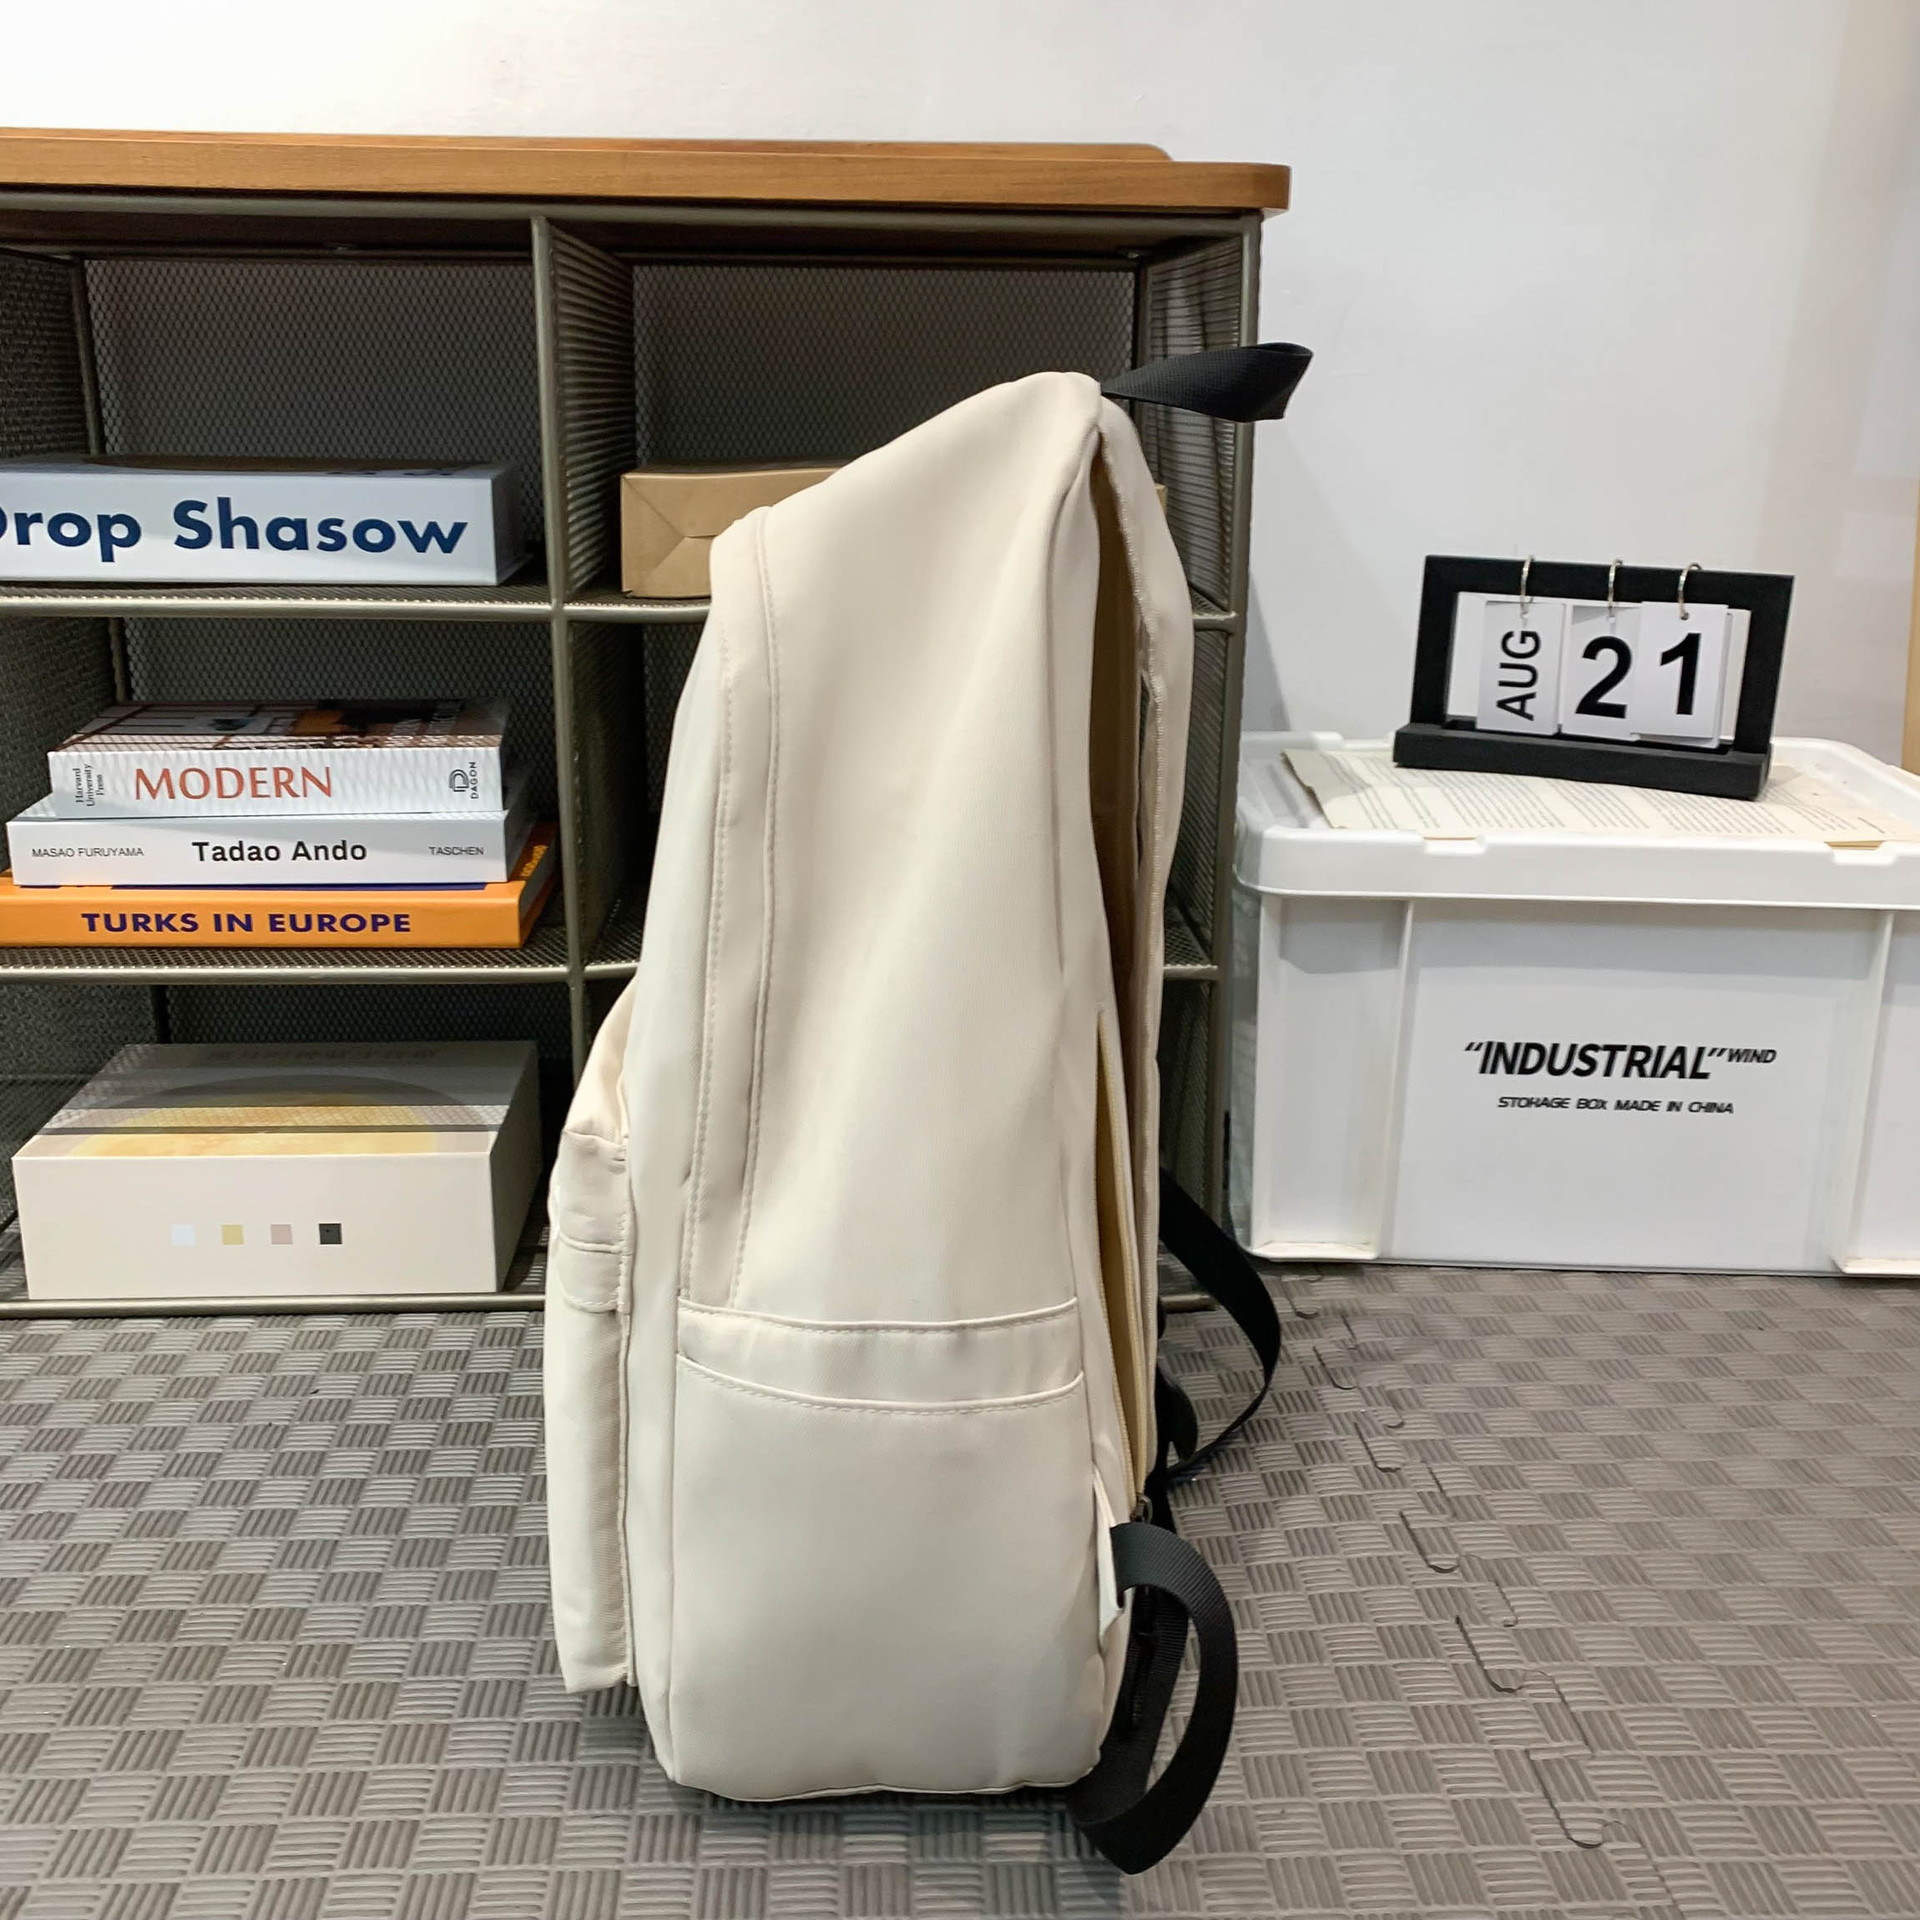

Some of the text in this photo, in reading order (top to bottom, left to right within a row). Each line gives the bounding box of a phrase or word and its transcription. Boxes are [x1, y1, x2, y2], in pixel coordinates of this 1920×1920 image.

[0, 496, 468, 562] rop Shasow
[1496, 630, 1541, 721] AUG
[74, 767, 84, 803] Harvard
[85, 763, 94, 807] University
[135, 767, 332, 800] MODERN
[469, 761, 479, 799] DAGON
[31, 847, 144, 858] MASAO FURUYAMA
[191, 839, 367, 862] Tadao Ando
[428, 846, 484, 856] TASCHEN
[81, 912, 411, 932] TURKS IN EUROPE
[1727, 1048, 1777, 1064] WIND
[1576, 1097, 1608, 1110] BOX
[1614, 1099, 1662, 1112] MADE
[1666, 1100, 1684, 1112] IN
[1687, 1101, 1734, 1114] CHINA
